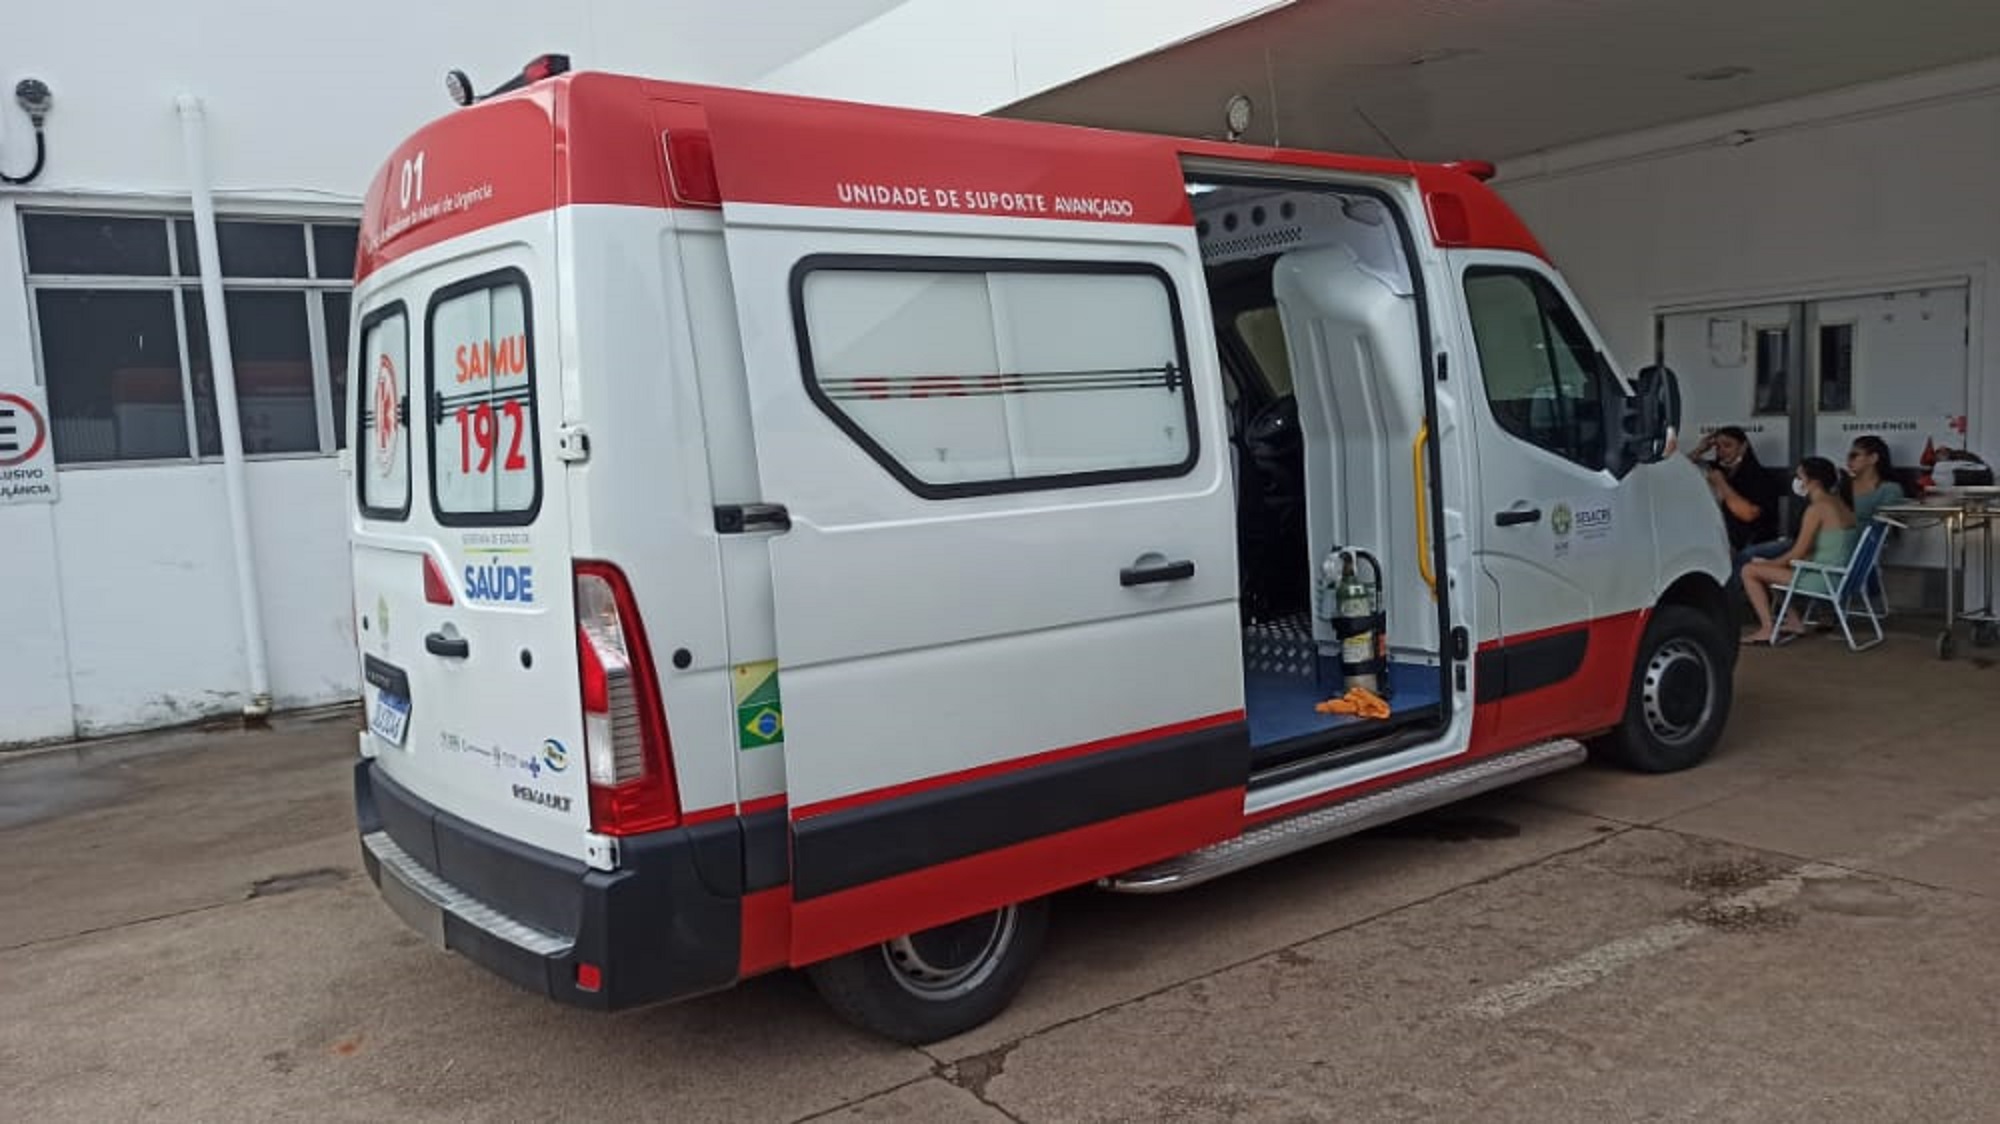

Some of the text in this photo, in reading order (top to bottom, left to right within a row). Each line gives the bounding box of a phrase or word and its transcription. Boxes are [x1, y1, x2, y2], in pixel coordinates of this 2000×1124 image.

[401, 151, 424, 209] 01
[837, 183, 1132, 217] UNIDADE DE SUPORTE AVANÇADO
[456, 333, 526, 383] SAMU
[456, 398, 527, 474] 192
[465, 556, 533, 602] SAÚDE
[512, 784, 572, 811] RENAULT
